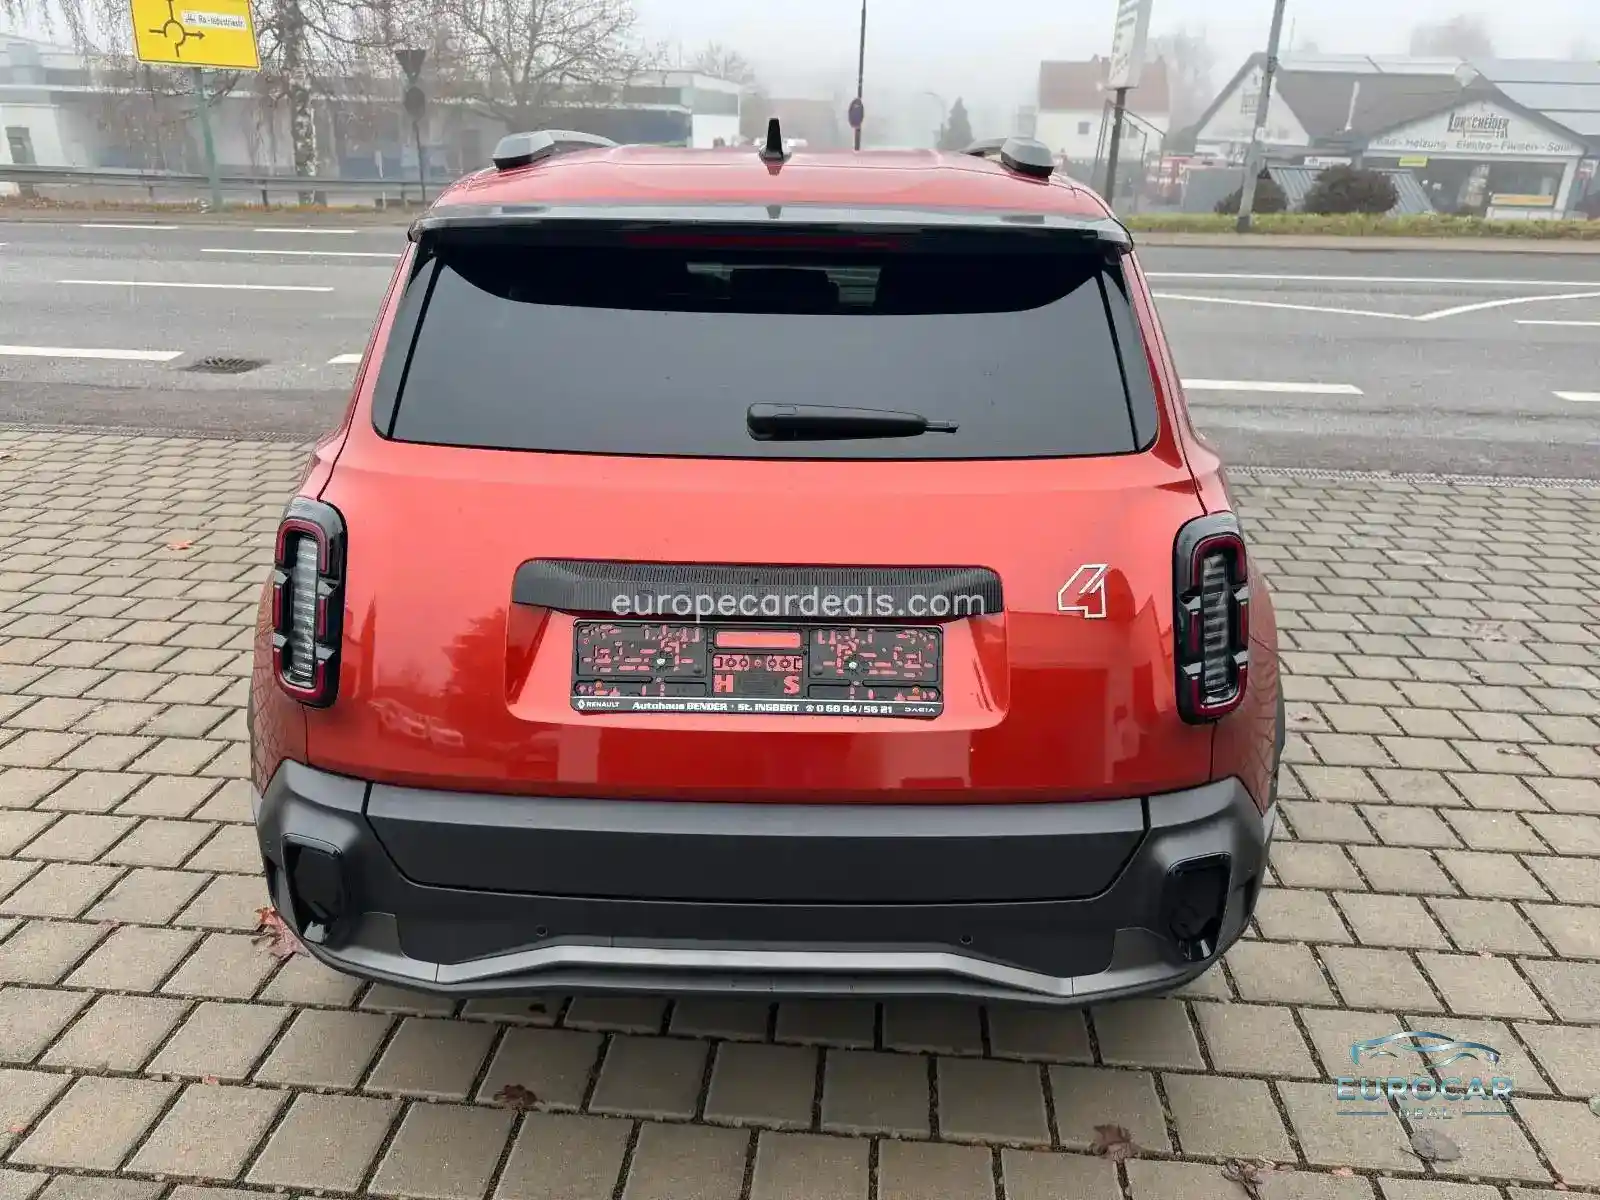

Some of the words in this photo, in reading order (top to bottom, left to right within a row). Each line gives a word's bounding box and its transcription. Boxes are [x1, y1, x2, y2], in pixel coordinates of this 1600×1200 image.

[1058, 563, 1107, 618] 4
[632, 702, 685, 710] Autohaus
[686, 703, 728, 711] BENDER
